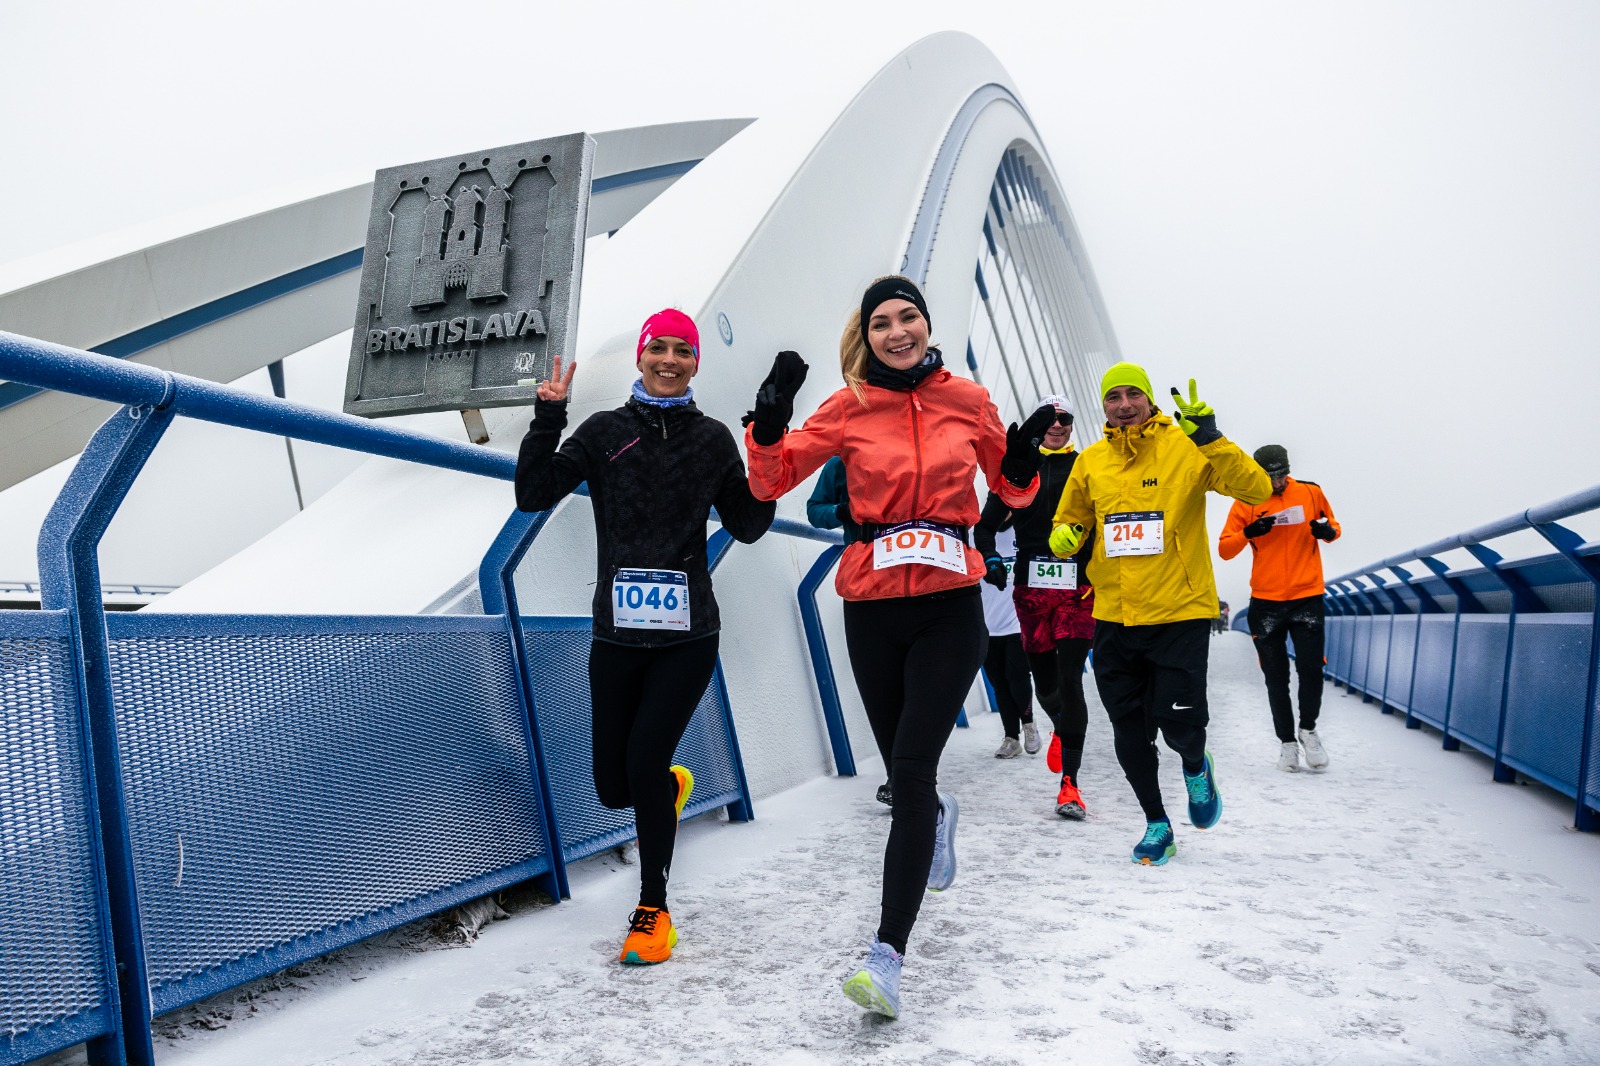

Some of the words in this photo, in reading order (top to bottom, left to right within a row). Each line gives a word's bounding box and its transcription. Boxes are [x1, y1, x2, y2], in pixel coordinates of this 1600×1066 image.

[366, 309, 547, 354] BRATISLAVA
[1142, 478, 1158, 488] HH
[881, 530, 946, 553] 1071
[1112, 523, 1145, 542] 214
[1036, 563, 1063, 578] 541
[614, 585, 679, 611] 1046
